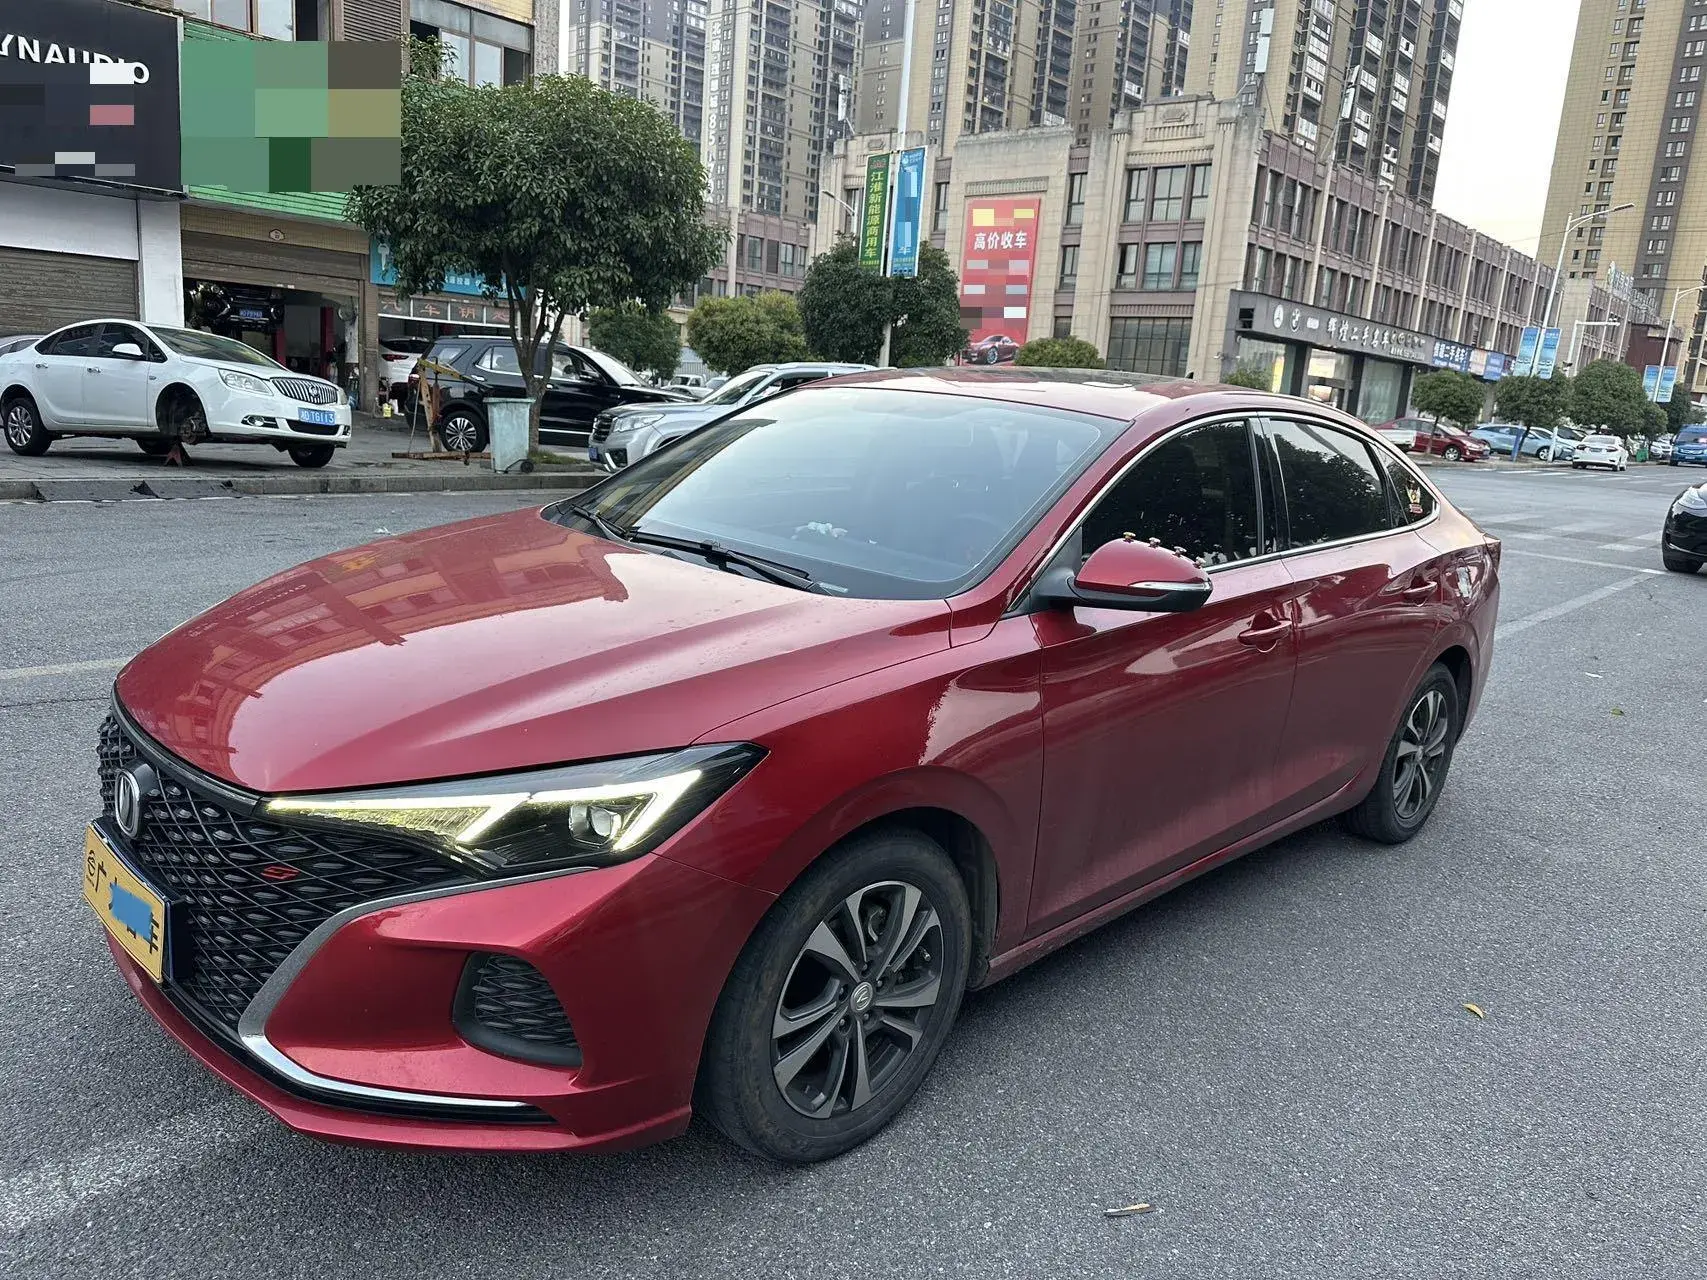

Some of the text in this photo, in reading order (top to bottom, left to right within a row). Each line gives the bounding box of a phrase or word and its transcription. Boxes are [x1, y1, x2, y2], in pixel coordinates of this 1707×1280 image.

[0, 33, 150, 84] YNAUO
[864, 171, 884, 258] 江淮新能源商用车
[973, 230, 1028, 250] 高价收车
